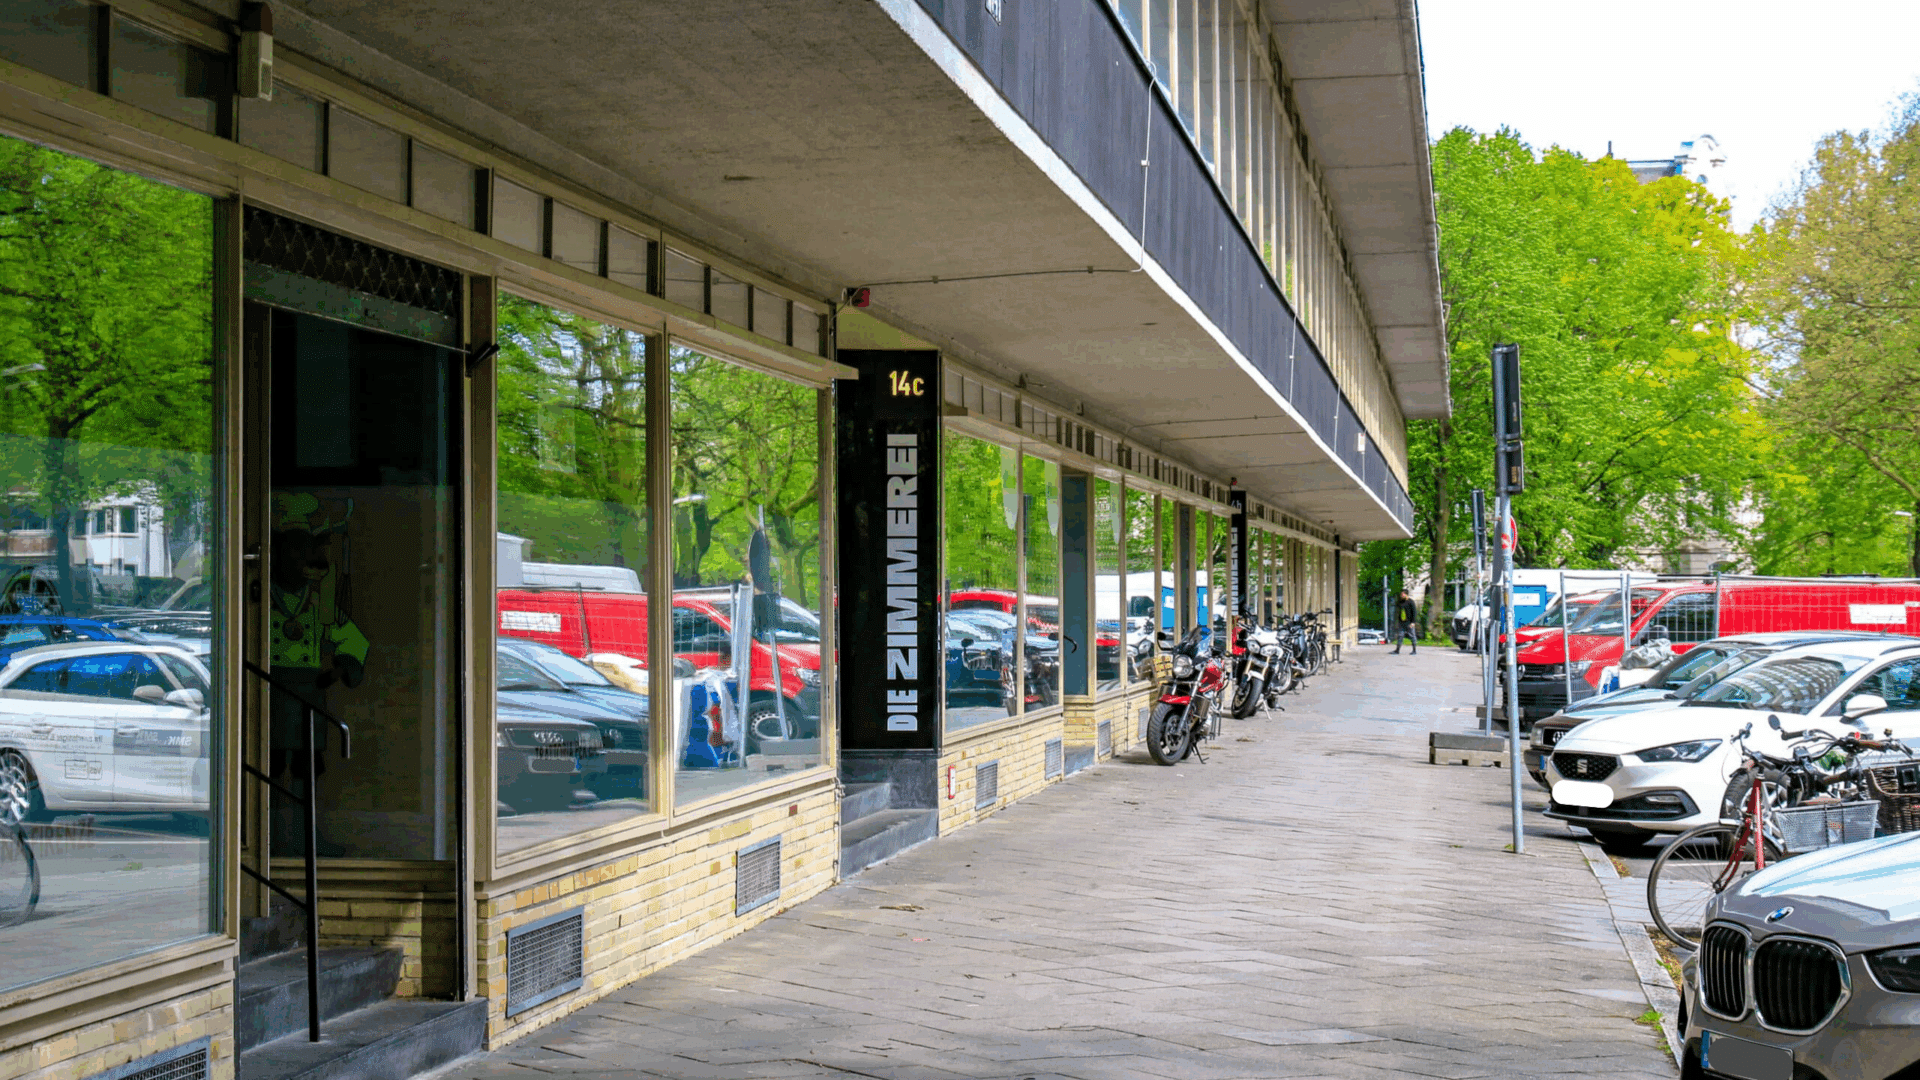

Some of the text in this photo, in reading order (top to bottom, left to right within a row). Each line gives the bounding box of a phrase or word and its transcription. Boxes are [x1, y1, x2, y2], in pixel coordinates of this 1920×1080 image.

[889, 370, 925, 396] 14c
[887, 433, 918, 731] DIE ZIMMEREI
